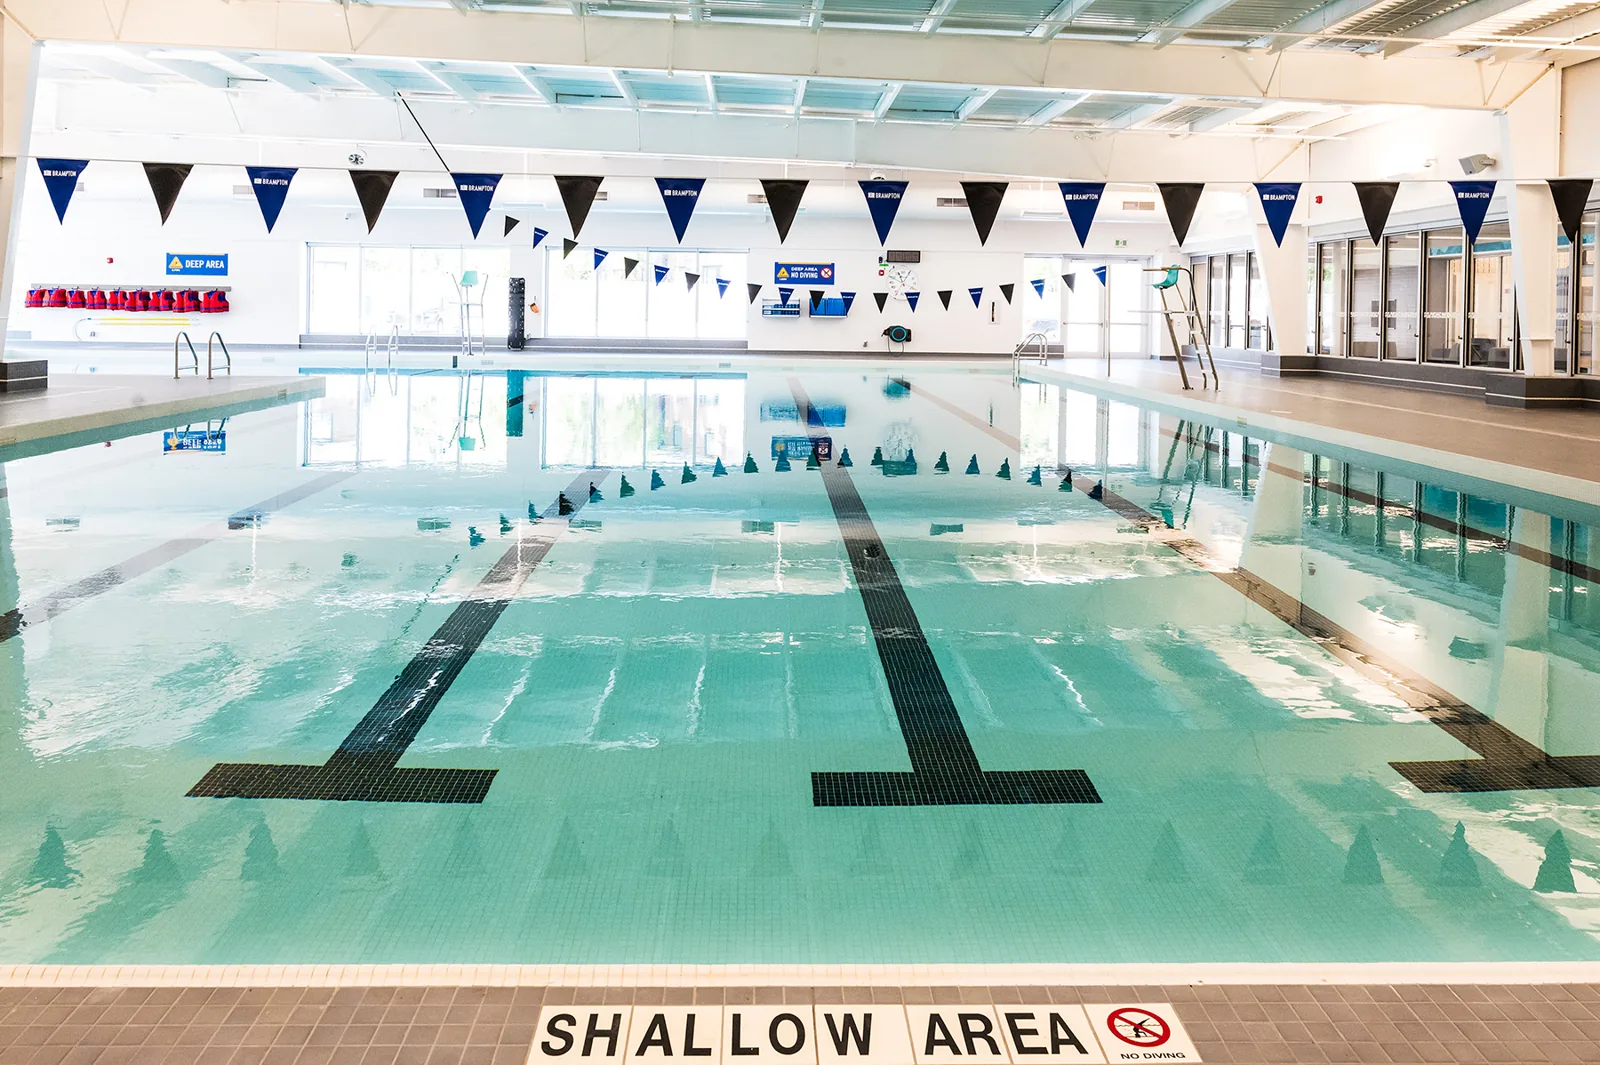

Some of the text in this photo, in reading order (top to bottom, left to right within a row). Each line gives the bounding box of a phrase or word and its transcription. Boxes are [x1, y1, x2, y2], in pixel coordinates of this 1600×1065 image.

[185, 259, 225, 269] DEEP AREA
[542, 1012, 1089, 1057] SHALLOW AREA
[1120, 1052, 1186, 1060] NO DIVING
